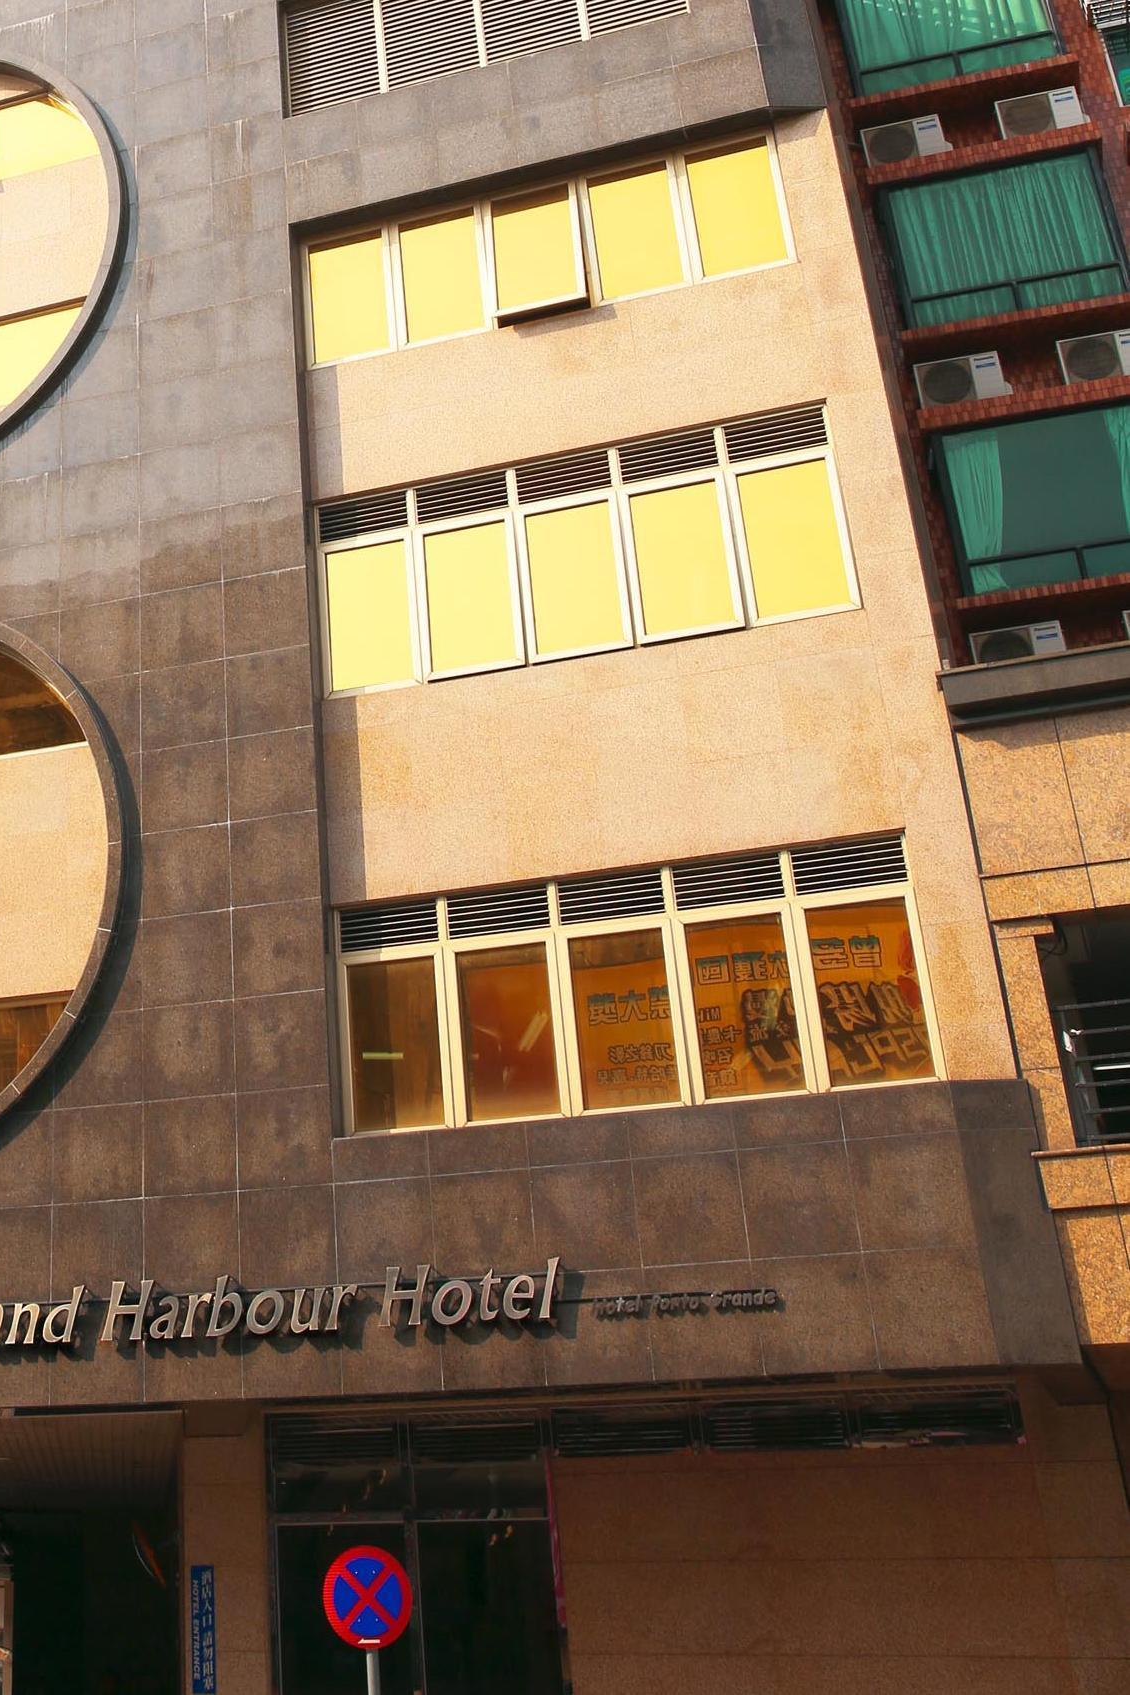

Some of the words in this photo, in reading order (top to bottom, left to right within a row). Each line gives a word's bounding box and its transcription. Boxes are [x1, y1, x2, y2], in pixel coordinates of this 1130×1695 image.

[99, 1274, 358, 1342] Harbour
[377, 1256, 560, 1328] Hotel
[192, 1618, 201, 1680] ENTRANCE
